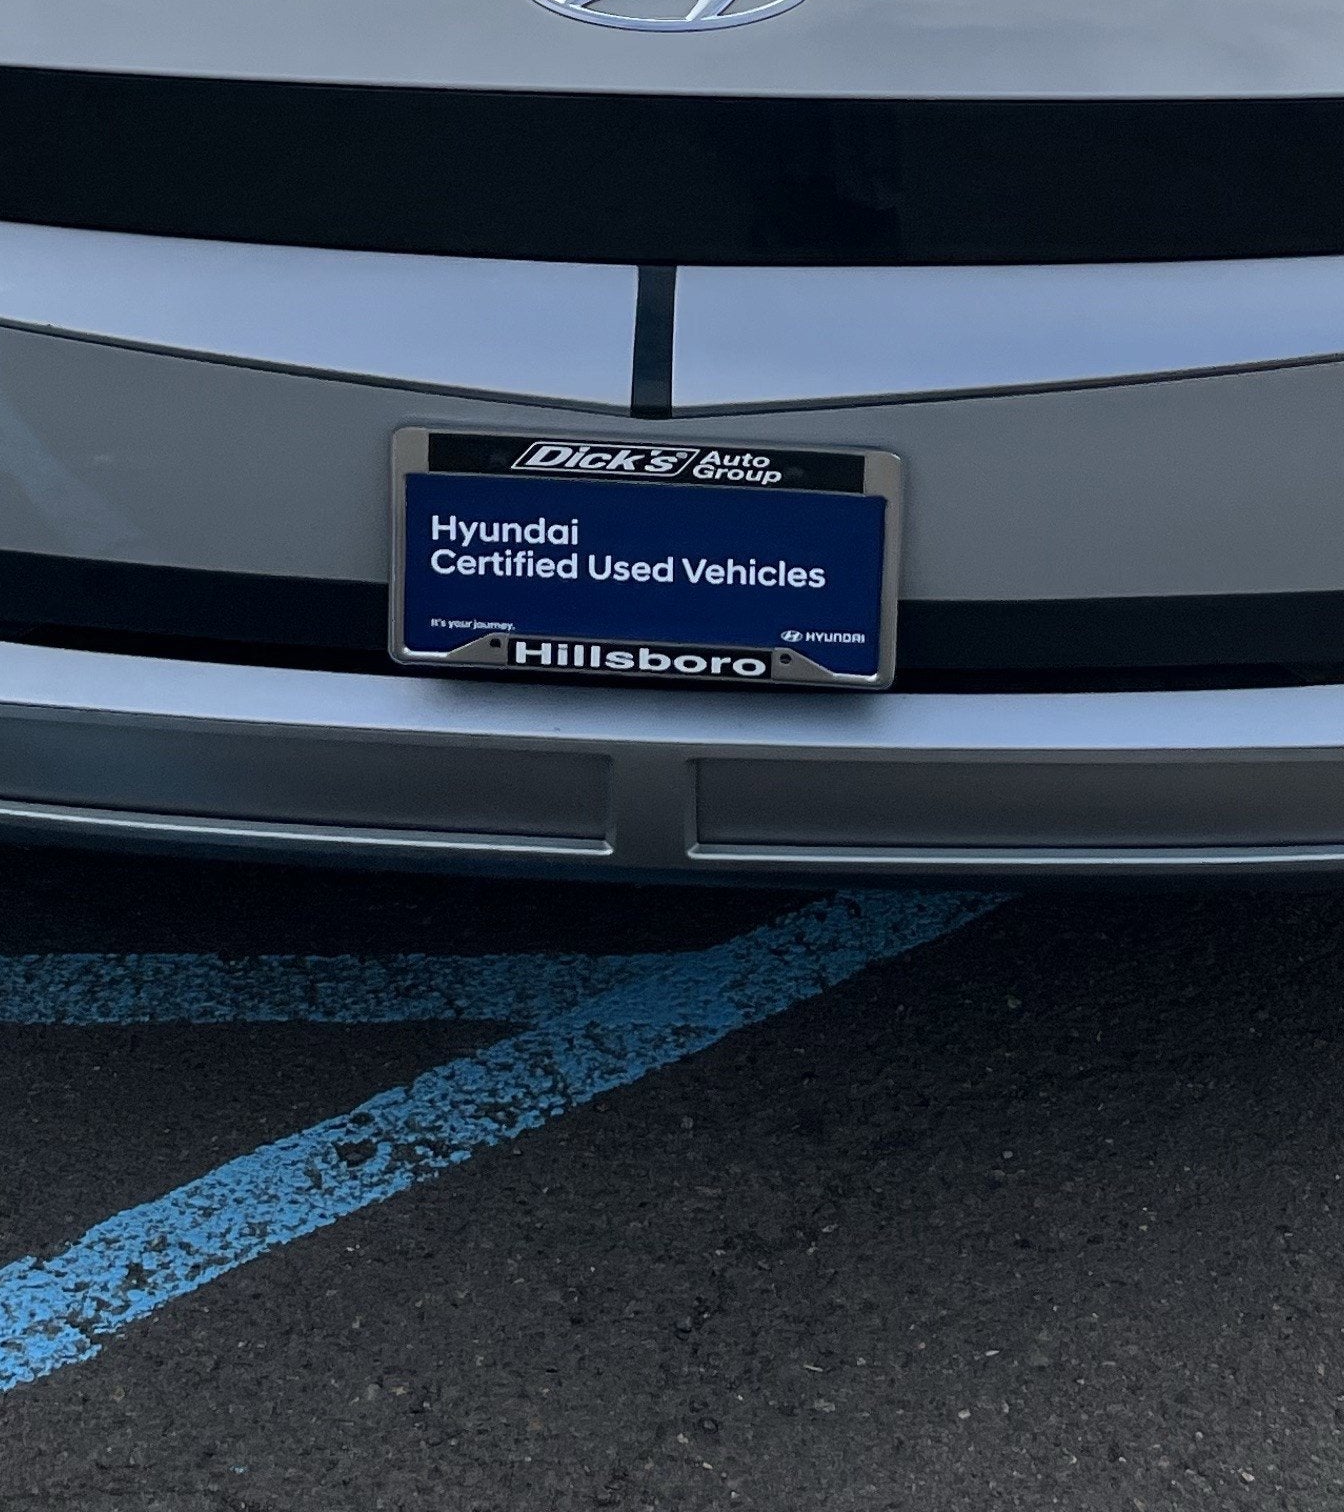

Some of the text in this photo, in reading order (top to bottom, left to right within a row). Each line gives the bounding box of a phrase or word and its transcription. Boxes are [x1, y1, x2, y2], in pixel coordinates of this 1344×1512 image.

[524, 445, 679, 473] Dick's
[699, 450, 771, 468] Auto
[692, 464, 783, 485] Group
[431, 514, 579, 546] Hyundai
[430, 548, 827, 589] Certified Used Vehicles
[448, 620, 473, 629] your
[805, 632, 866, 644] HYUNDAI
[515, 641, 767, 676] Hillsboro
